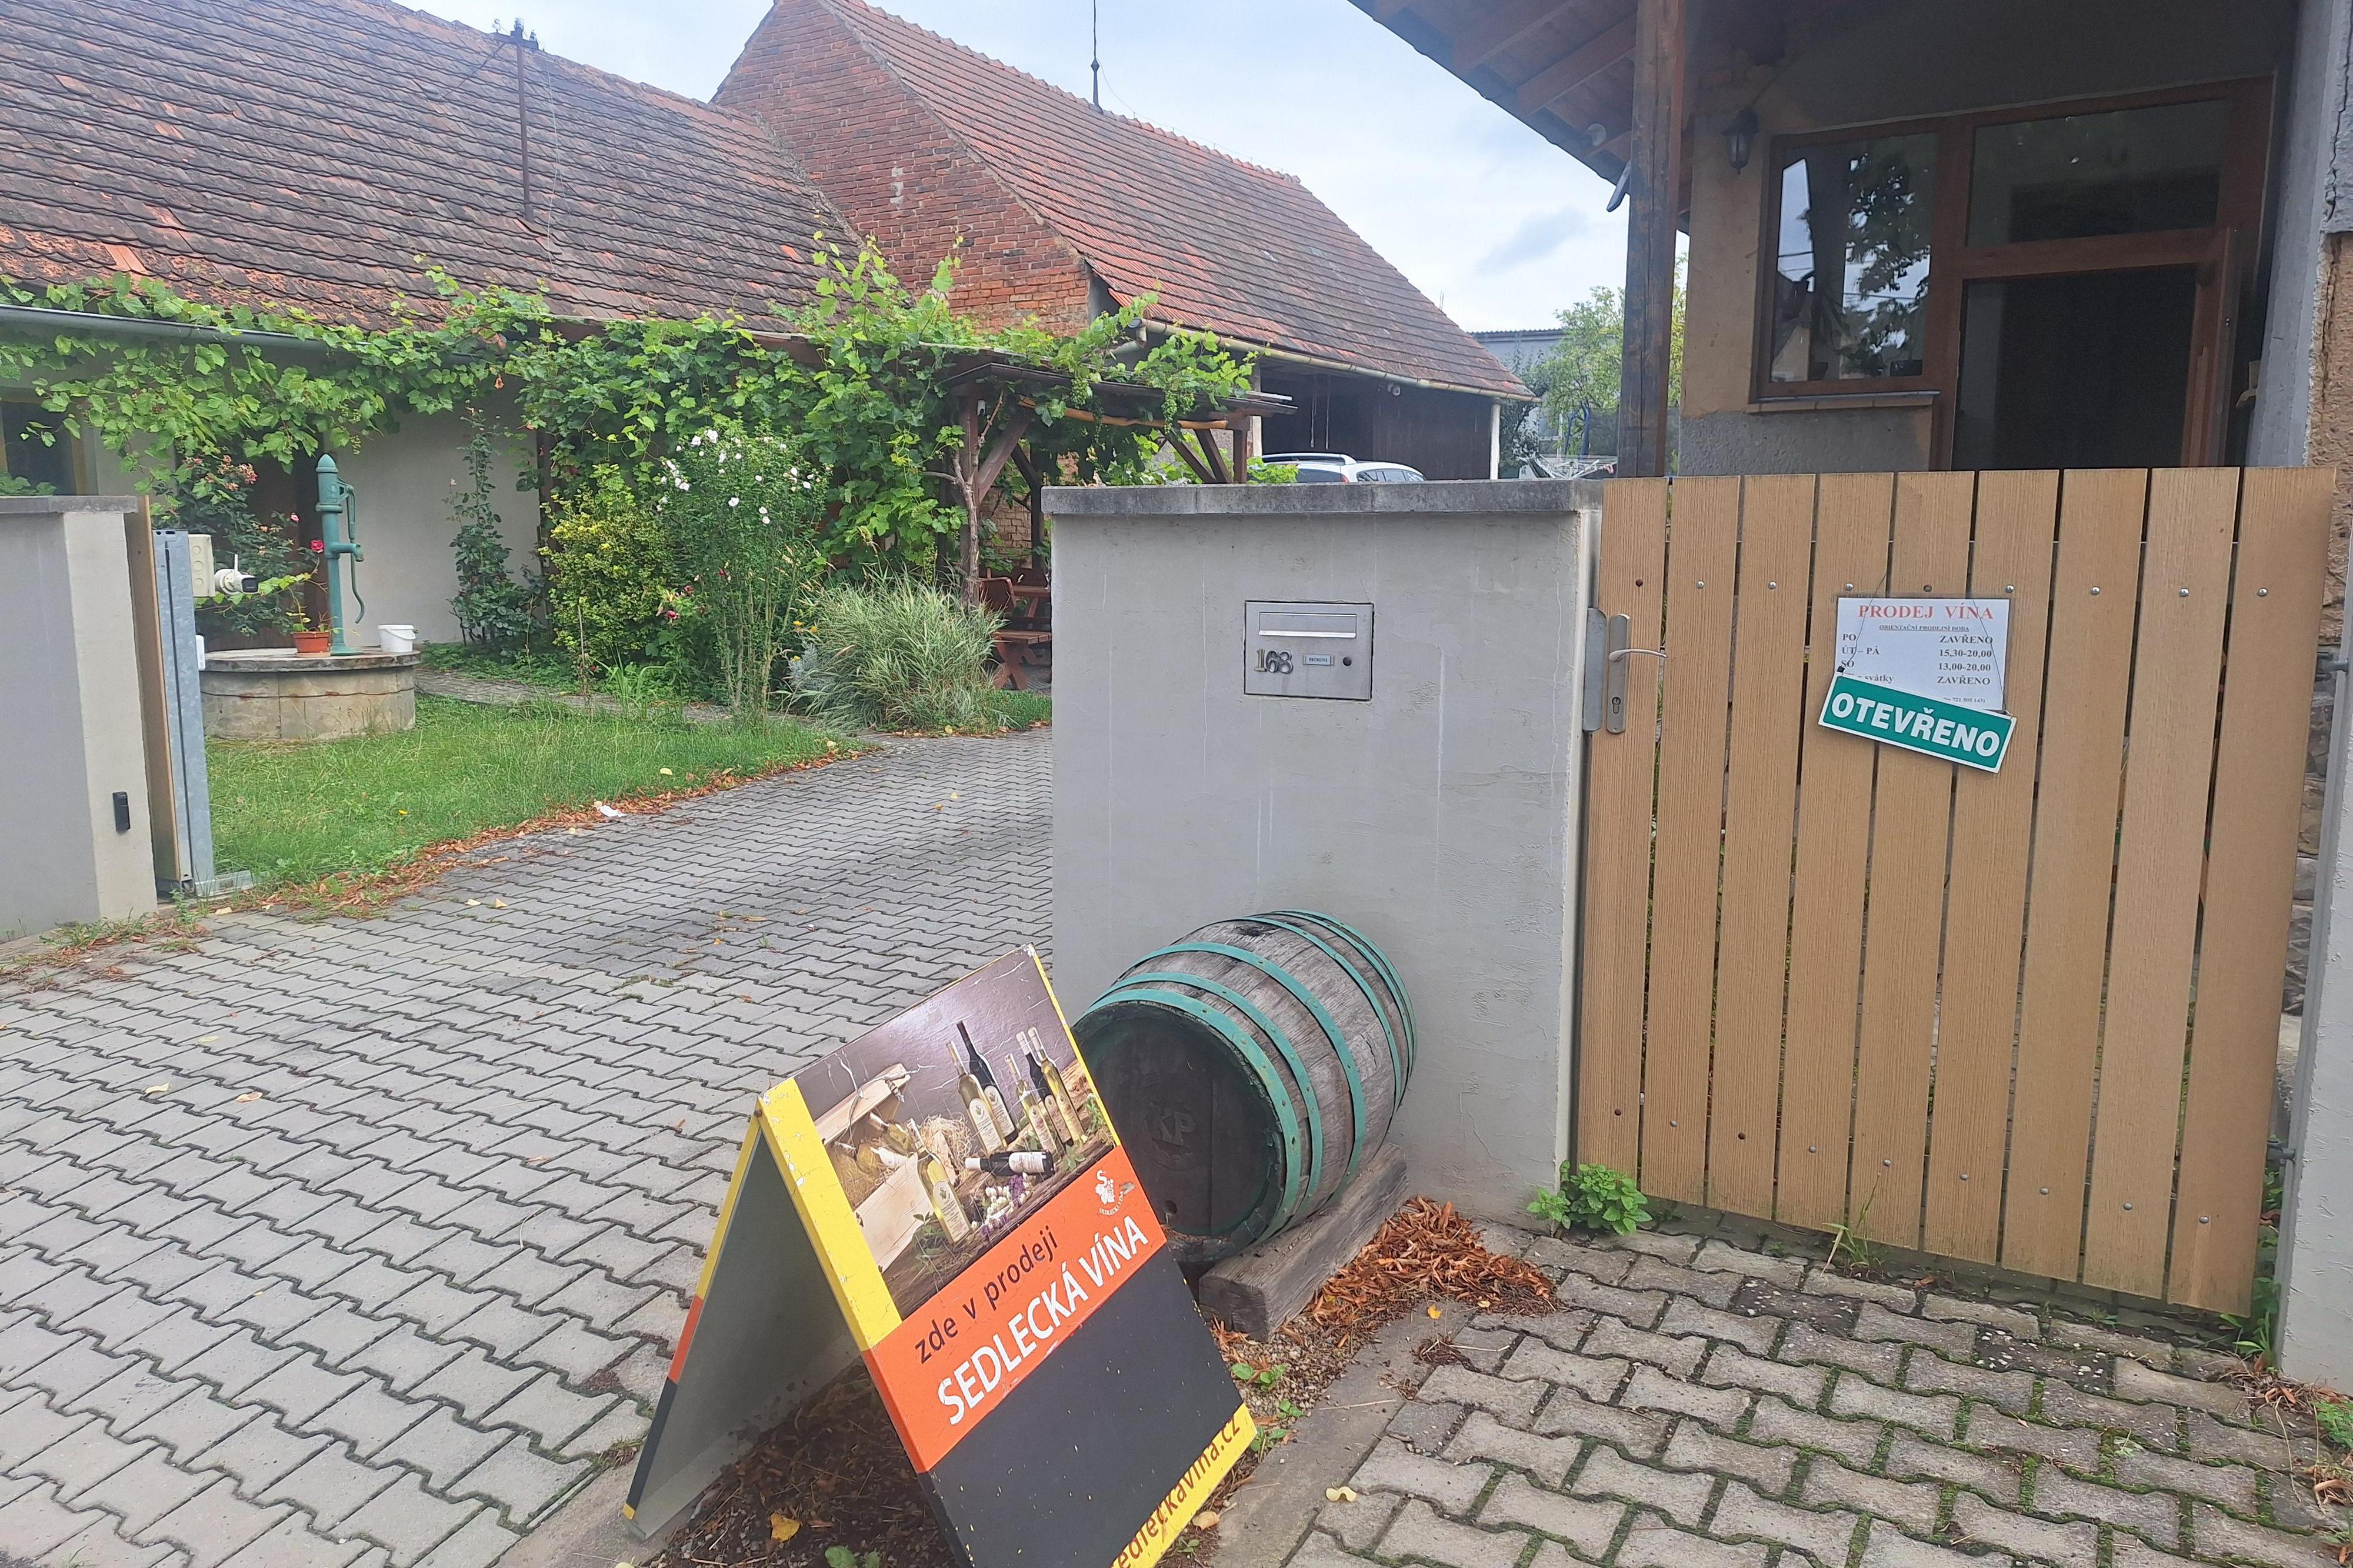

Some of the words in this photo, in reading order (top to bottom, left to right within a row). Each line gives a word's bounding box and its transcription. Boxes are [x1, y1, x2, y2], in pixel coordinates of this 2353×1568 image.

[1859, 605, 1934, 619] PRODEJ
[1945, 602, 1994, 619] VÍNA
[1939, 634, 1993, 644] ZAVŘENO
[1842, 645, 1857, 655] ÚT
[1867, 645, 1880, 655] PÁ
[1939, 649, 1992, 658] 15,30-20,00
[1254, 648, 1294, 674] 168
[1938, 662, 1991, 672] 13,00-20,00
[1864, 674, 1894, 683] svátky
[1937, 675, 1991, 685] ZAVŘENO
[1831, 692, 2000, 758] OTEVŘENO
[915, 1317, 959, 1365] zde
[962, 1297, 977, 1319] v
[983, 1225, 1058, 1311] prodeji
[937, 1260, 1089, 1426] SEDLECKÁ
[1078, 1215, 1149, 1288] VÍNA
